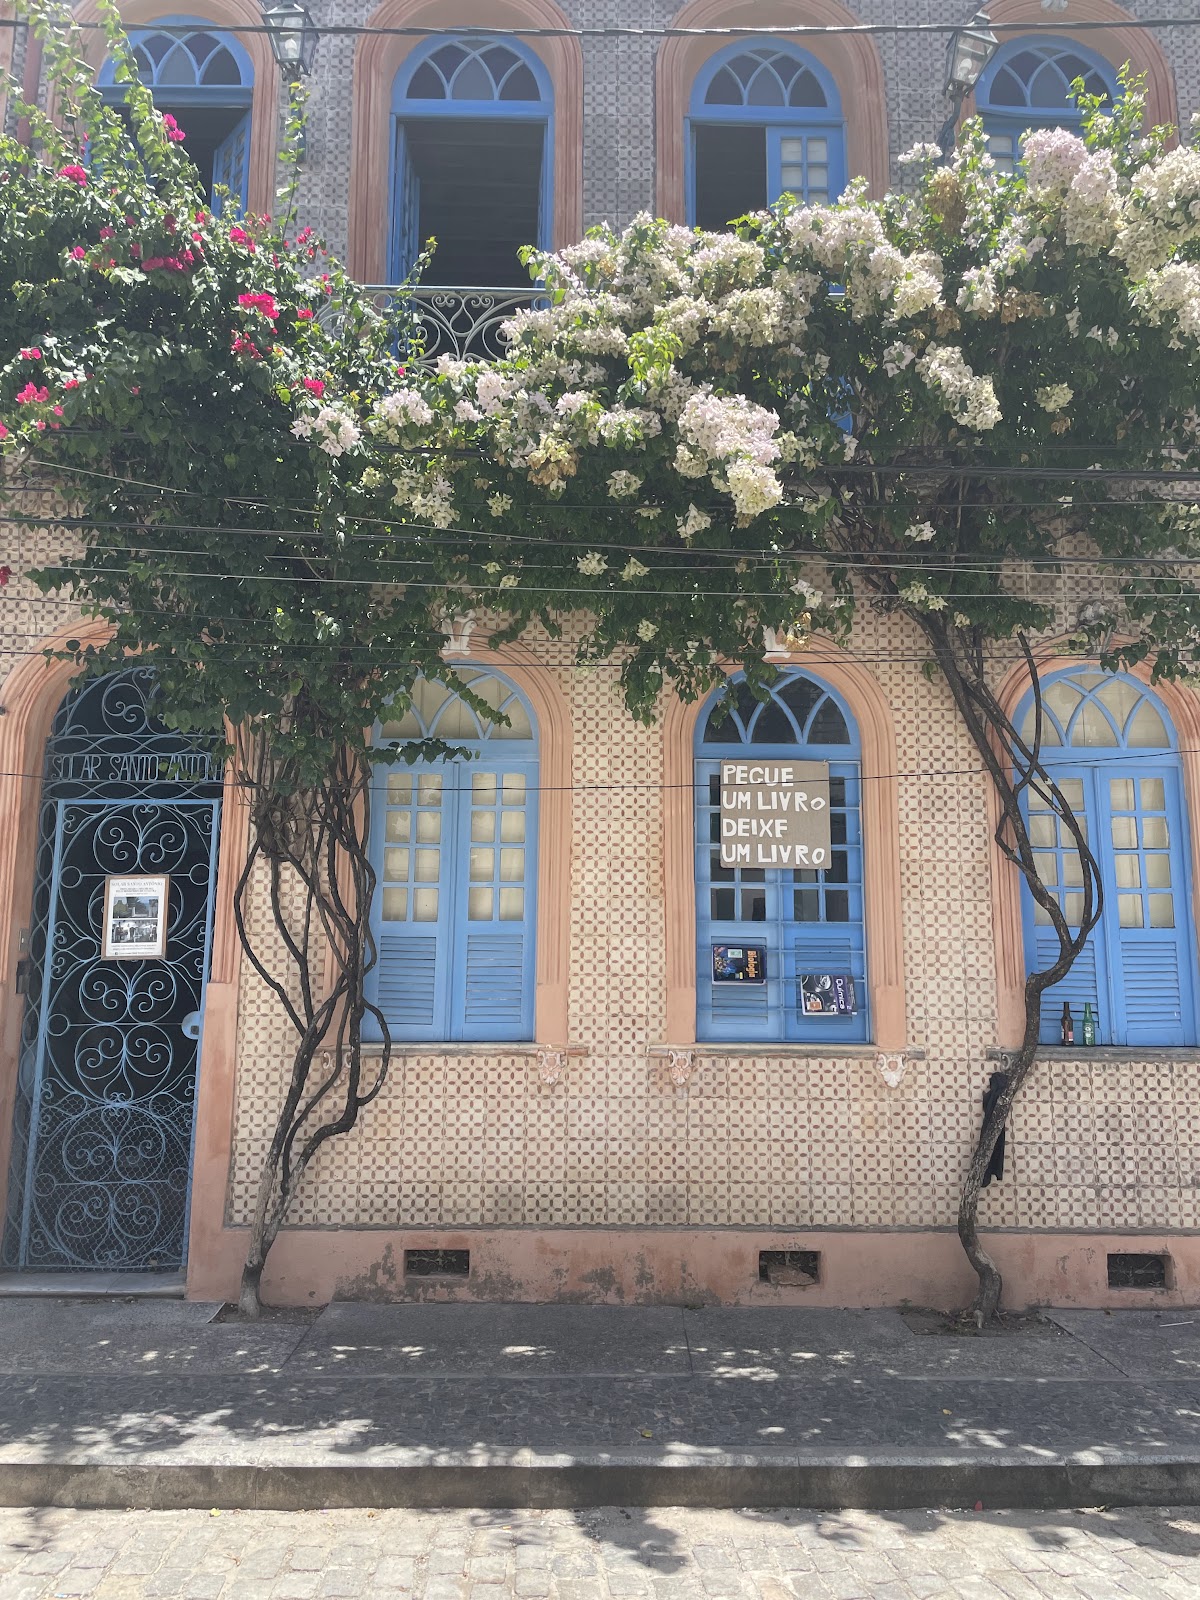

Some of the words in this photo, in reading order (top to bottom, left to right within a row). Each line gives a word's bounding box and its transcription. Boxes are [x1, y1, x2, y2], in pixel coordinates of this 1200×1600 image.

[51, 755, 101, 781] SOLAR
[109, 755, 158, 781] SANTO
[723, 764, 794, 787] PEGUE
[722, 791, 751, 810] UM
[757, 791, 826, 812] LIVRO
[721, 843, 750, 863] UM
[757, 843, 825, 865] LIVRO
[746, 950, 758, 978] Biologia
